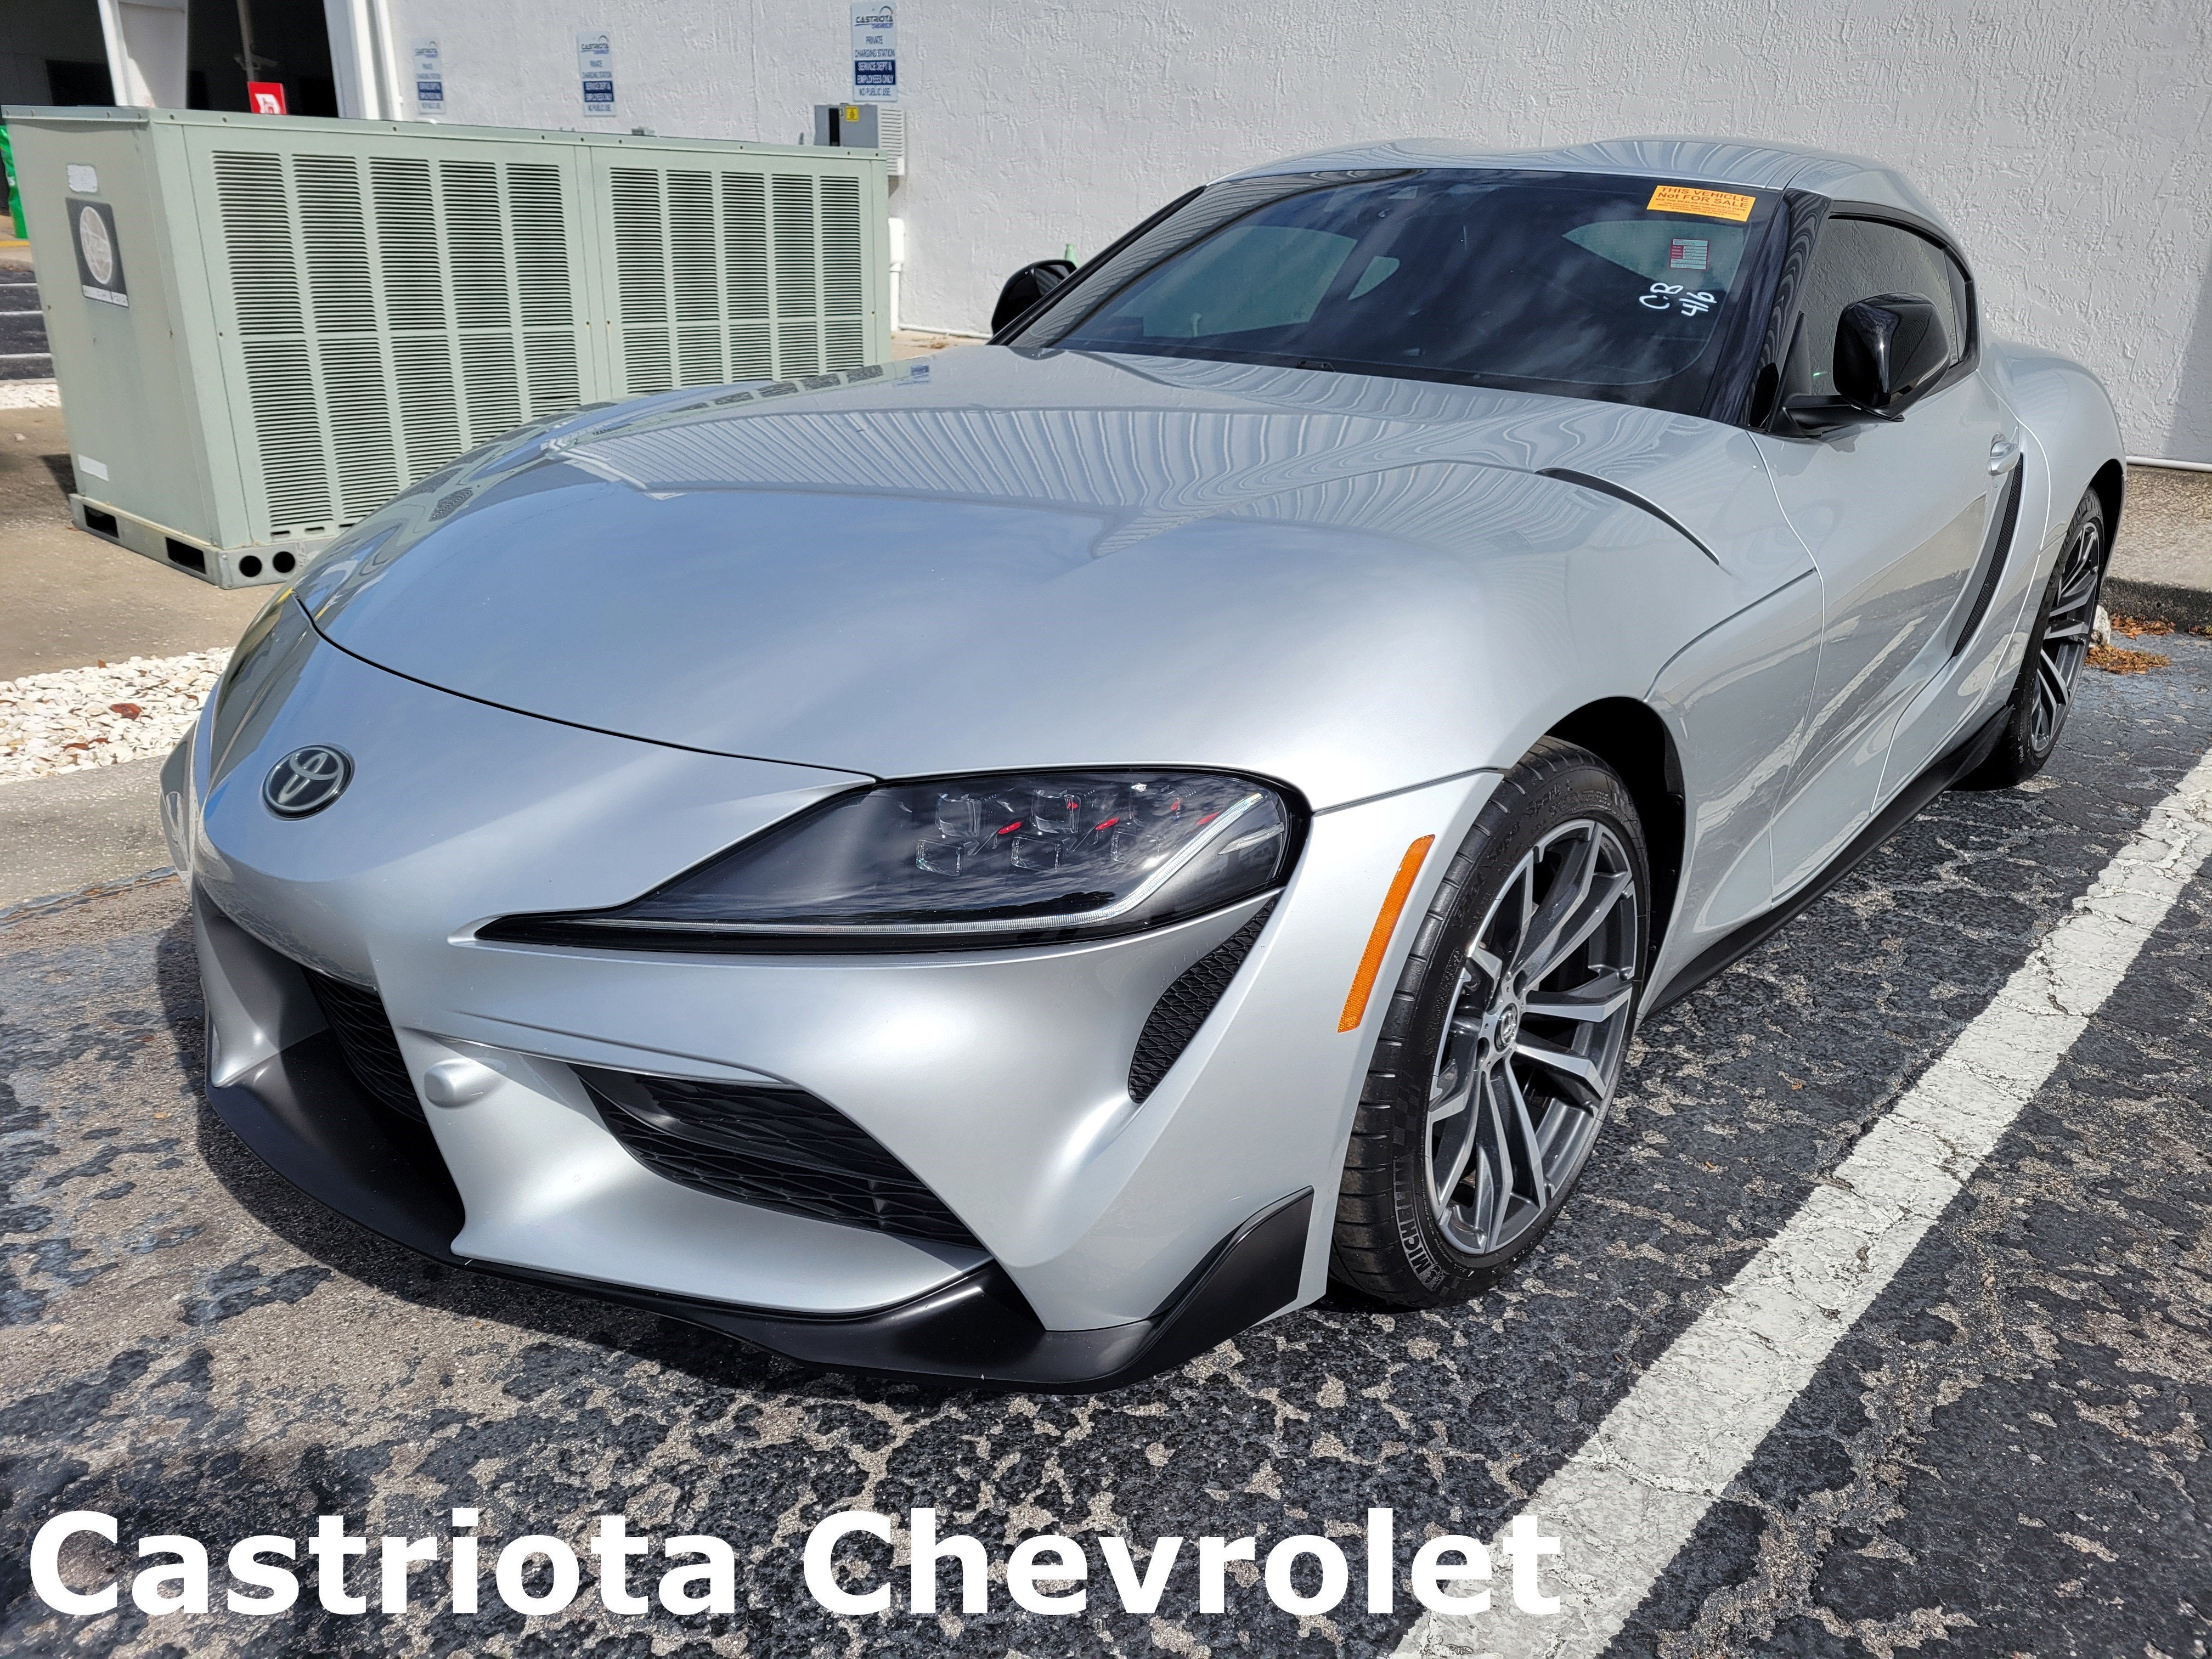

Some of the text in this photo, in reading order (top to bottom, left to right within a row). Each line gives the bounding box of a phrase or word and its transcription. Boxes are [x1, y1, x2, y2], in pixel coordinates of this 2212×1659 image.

[865, 36, 883, 44] PRIVATE
[1694, 190, 1750, 202] VEHICLE
[1714, 199, 1749, 208] SALE
